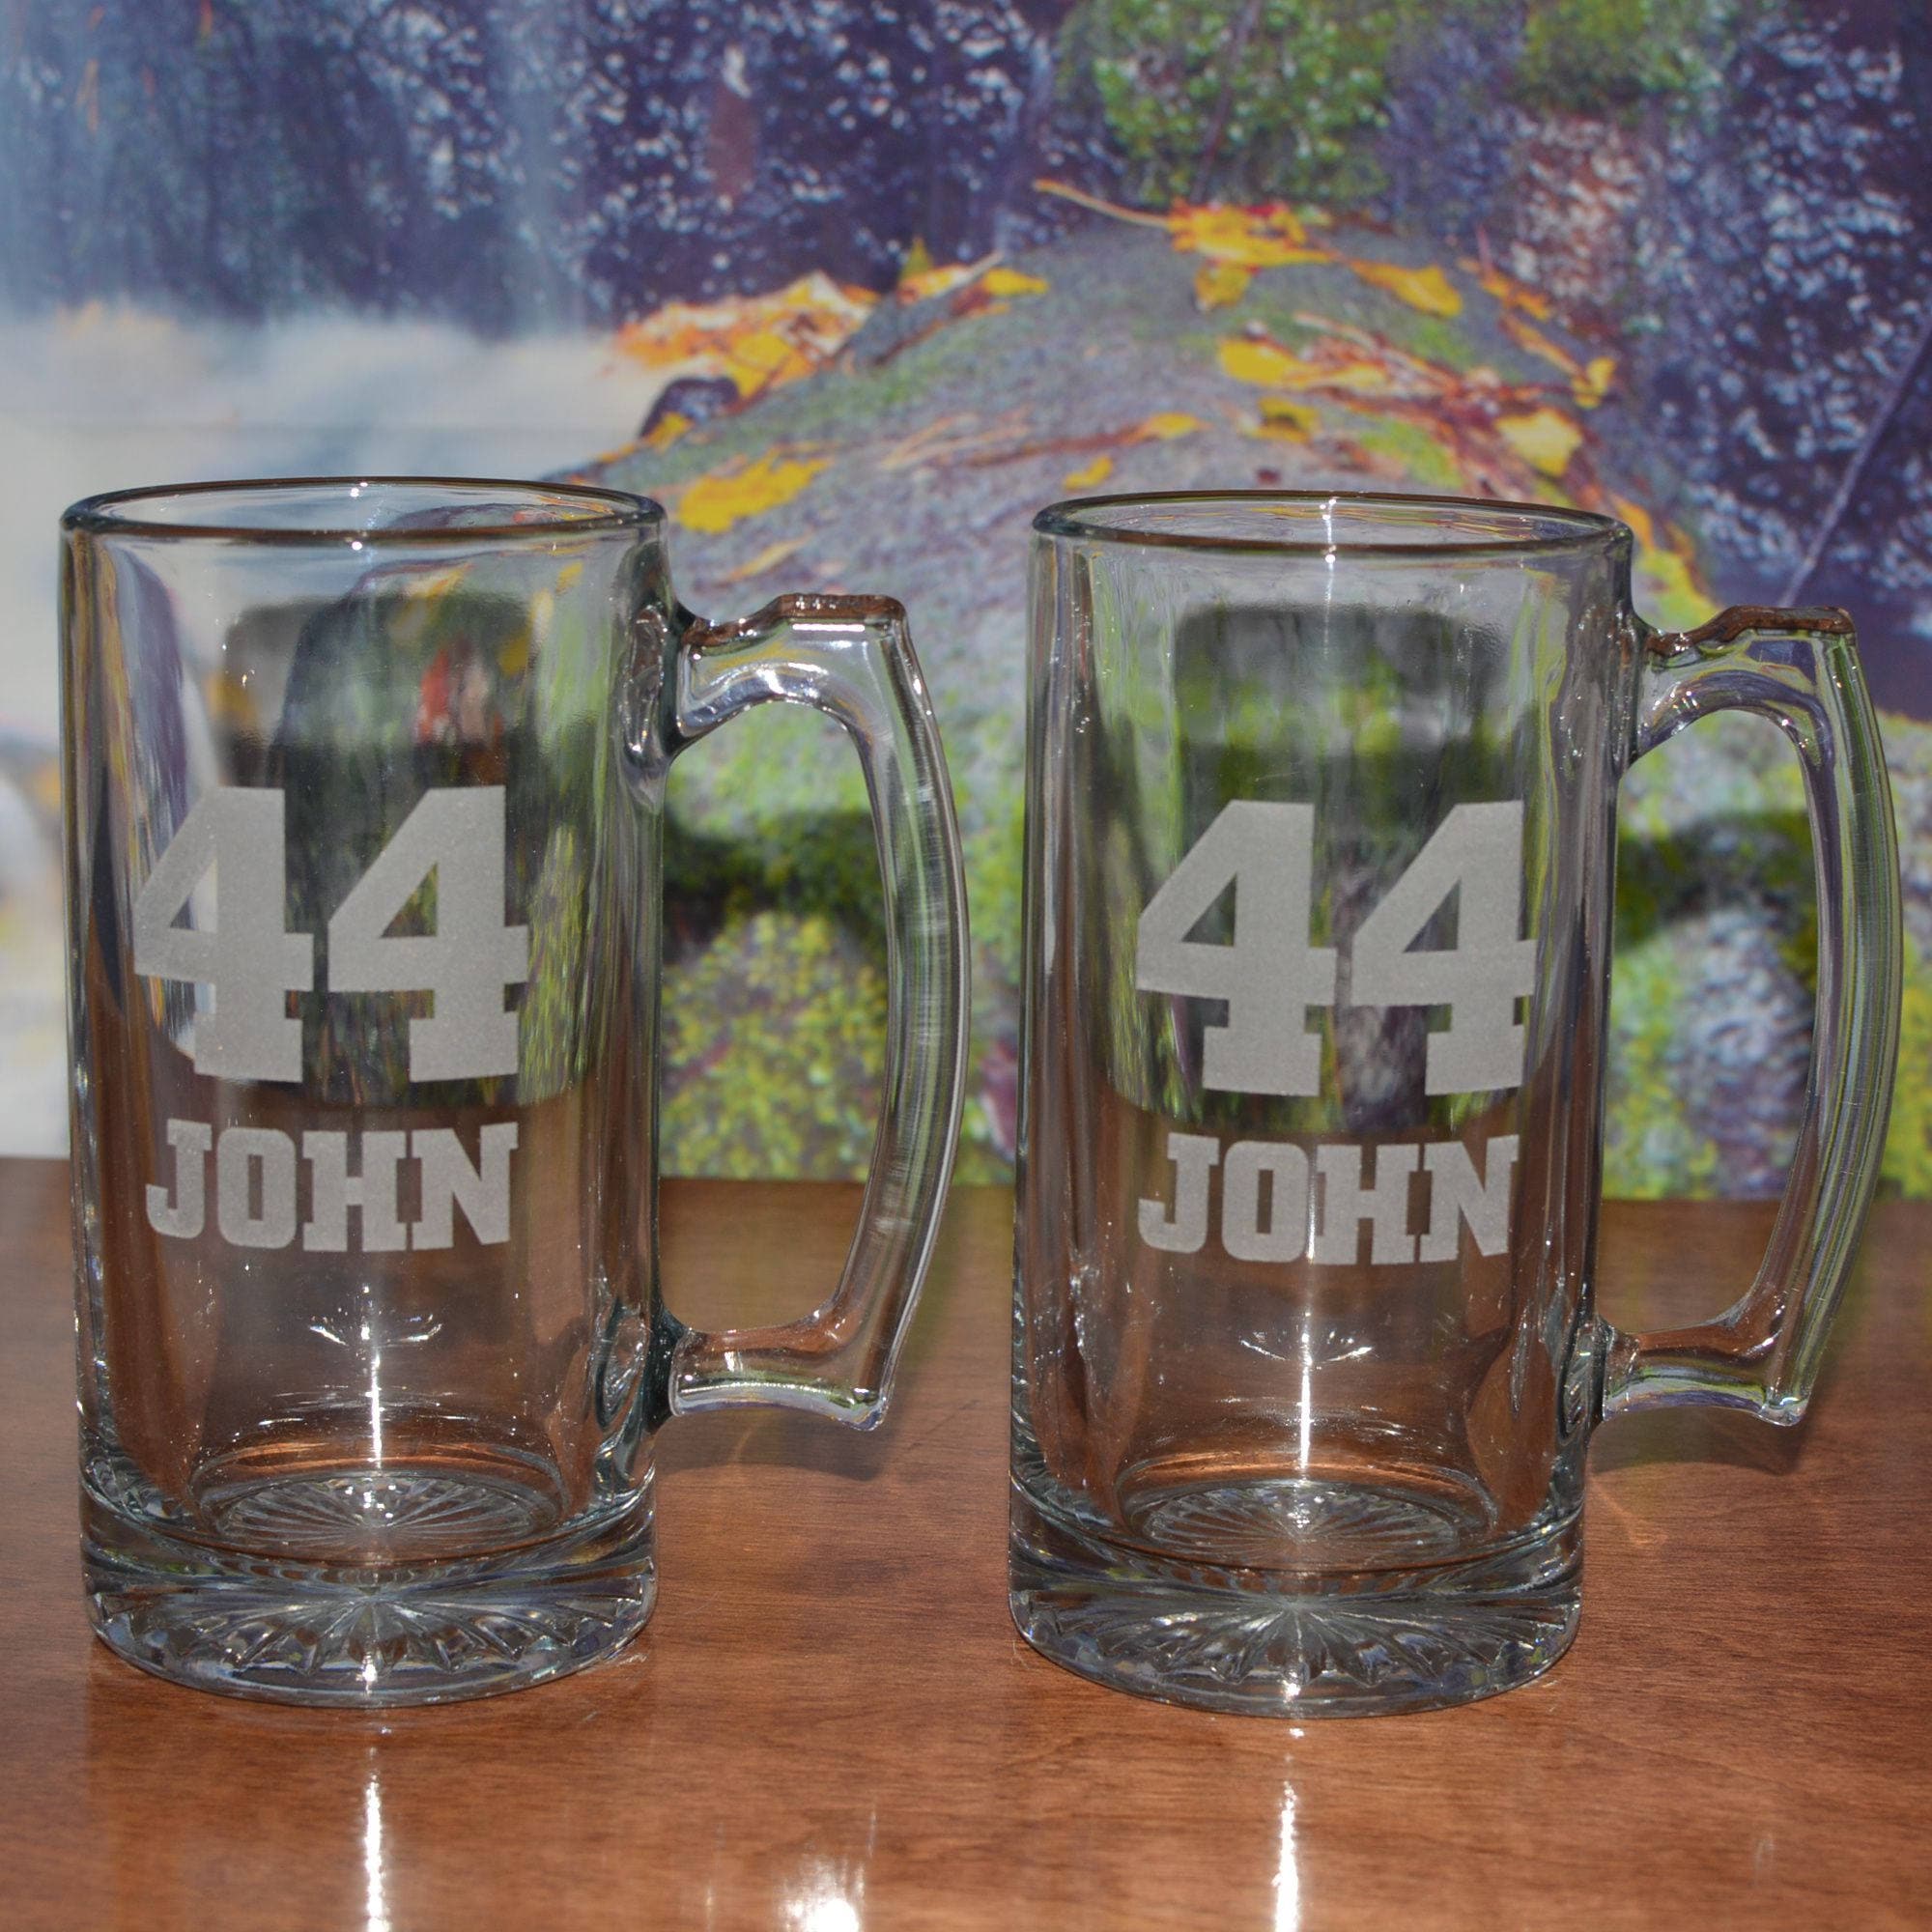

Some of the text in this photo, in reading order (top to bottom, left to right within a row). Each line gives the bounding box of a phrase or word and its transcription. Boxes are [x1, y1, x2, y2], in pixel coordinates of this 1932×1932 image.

[133, 785, 529, 1083] 44
[1136, 800, 1537, 1096] 44
[145, 1119, 520, 1252] JOHN
[1138, 1133, 1520, 1265] JOHN
